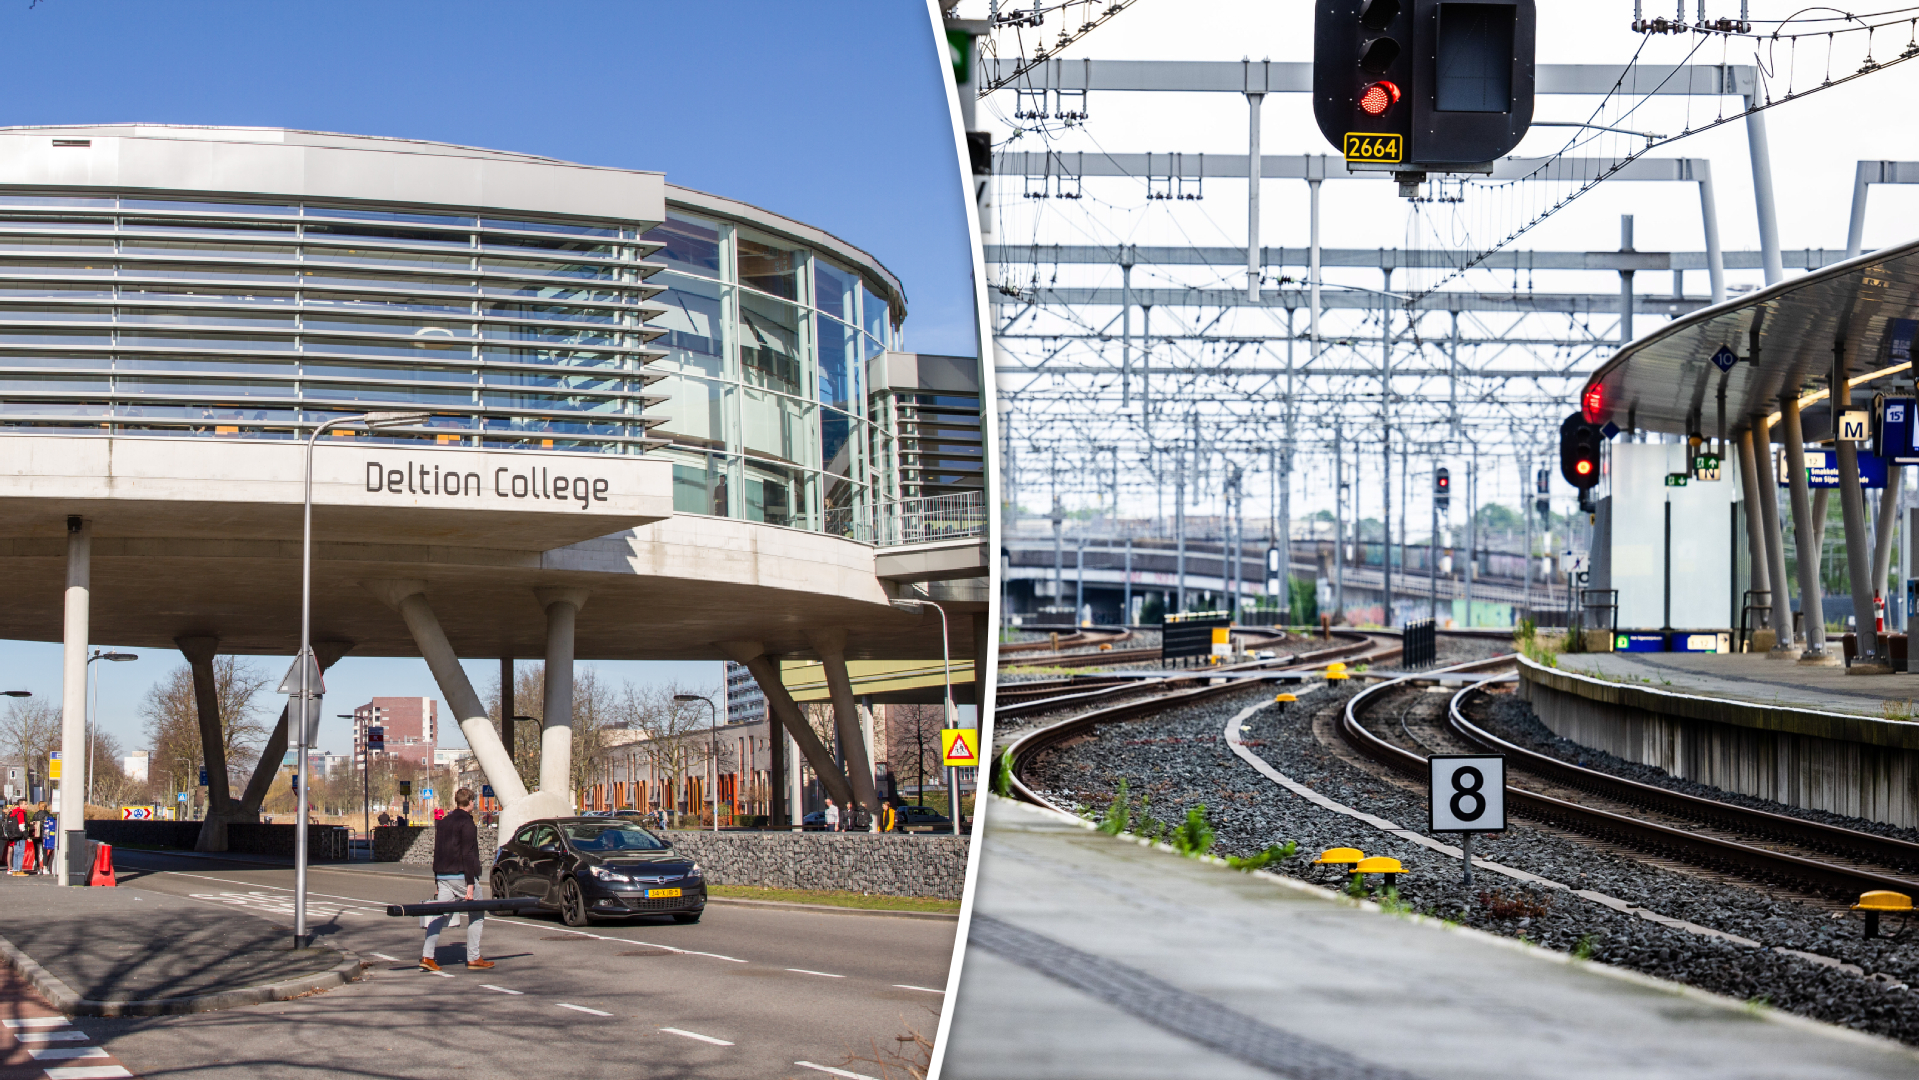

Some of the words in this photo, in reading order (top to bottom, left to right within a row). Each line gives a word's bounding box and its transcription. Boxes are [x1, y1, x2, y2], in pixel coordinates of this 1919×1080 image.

[1349, 137, 1397, 157] 2664
[1718, 353, 1733, 366] 10
[1845, 422, 1863, 438] M
[366, 461, 480, 496] Deltion
[495, 466, 609, 510] College
[1450, 766, 1486, 822] 8
